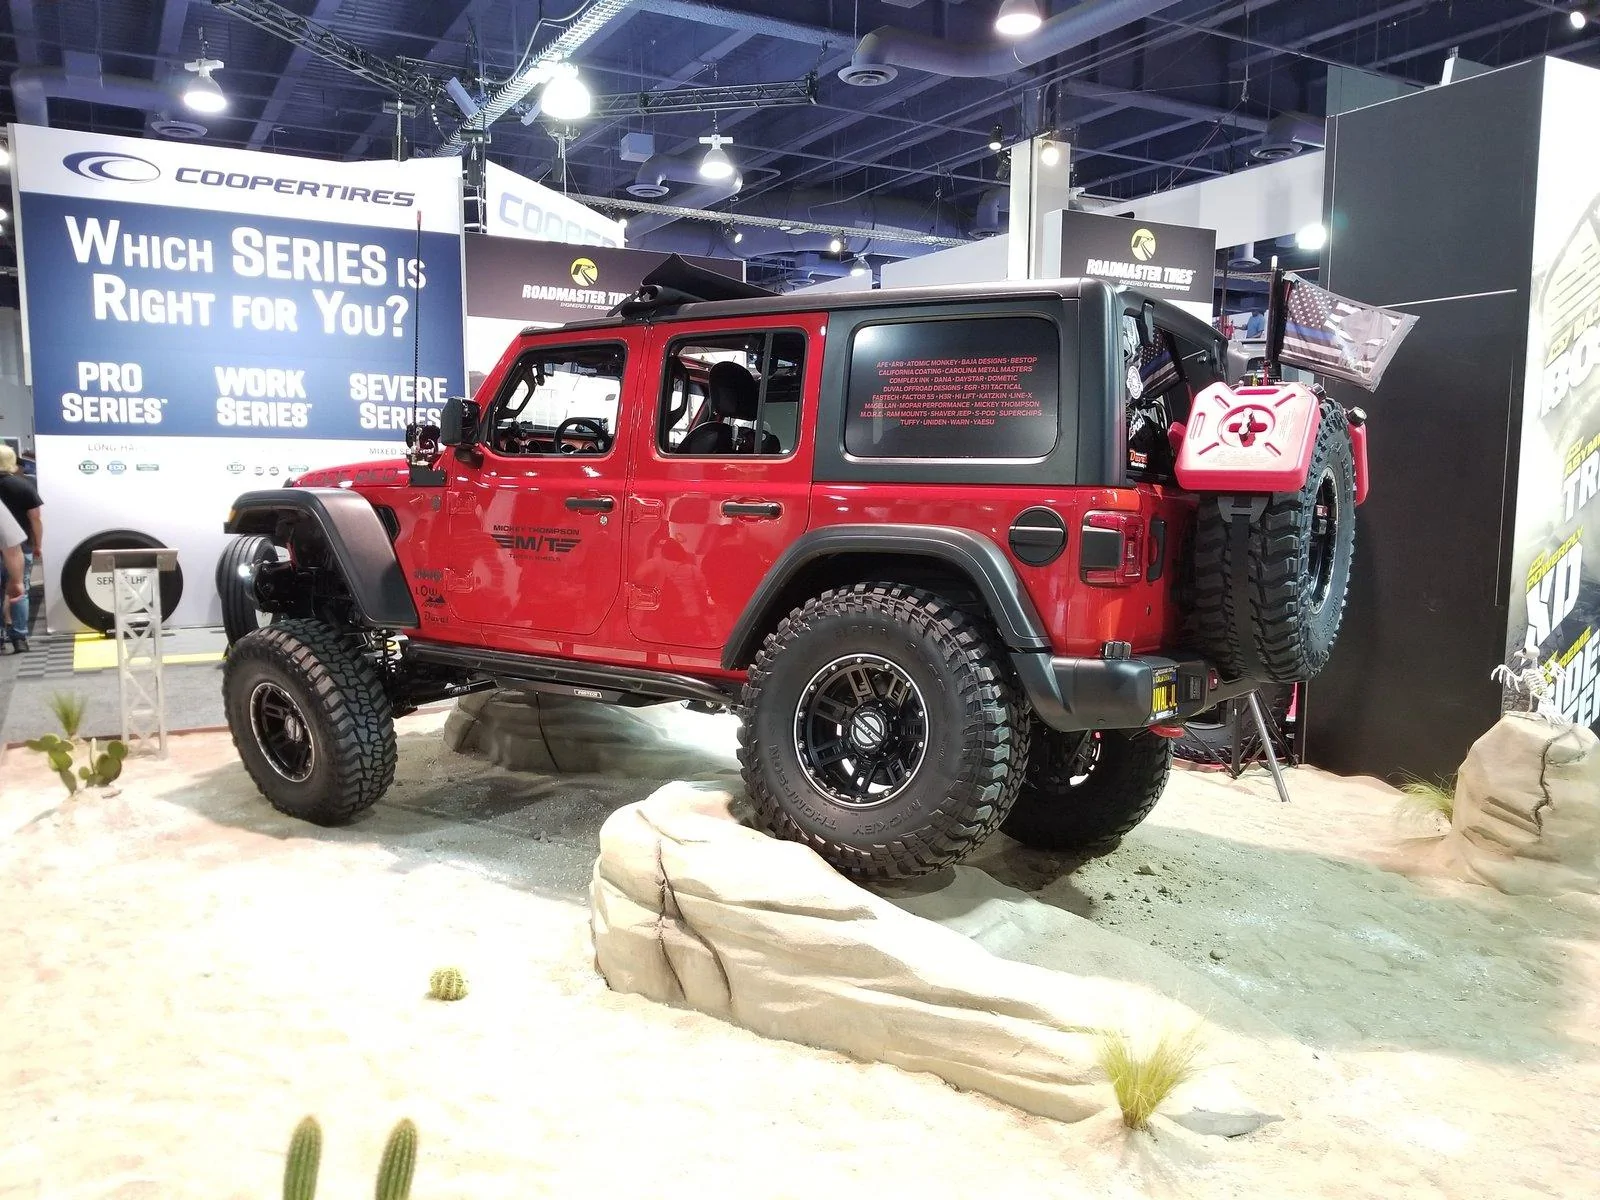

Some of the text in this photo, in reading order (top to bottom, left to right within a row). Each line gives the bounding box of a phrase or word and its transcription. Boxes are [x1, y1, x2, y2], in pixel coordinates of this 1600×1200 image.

[231, 226, 387, 286] SERIES
[1086, 258, 1194, 285] ROADMASTER TIRES
[522, 284, 607, 304] ROADMASTER
[92, 273, 409, 338] RIGHT FOR YOU?
[931, 359, 958, 367] MONKEY
[978, 357, 1007, 365] DESIGNS
[1010, 356, 1038, 364] BESTOP
[77, 361, 142, 393] PRO
[878, 368, 914, 376] CALIFORNIA
[914, 368, 942, 376] COATING
[945, 366, 977, 374] CAROLINA
[1000, 365, 1033, 373] MASTERS
[987, 374, 1018, 382] DOMETIC
[214, 366, 306, 399] WORK
[349, 372, 448, 403] SEVERE
[991, 382, 1022, 390] TACTICAL
[922, 401, 970, 409] PERFORMANCE
[1000, 400, 1040, 408] THOMPSON
[998, 409, 1042, 417] SUPERCHIPS
[493, 524, 580, 536] MICKEY THOMPSON
